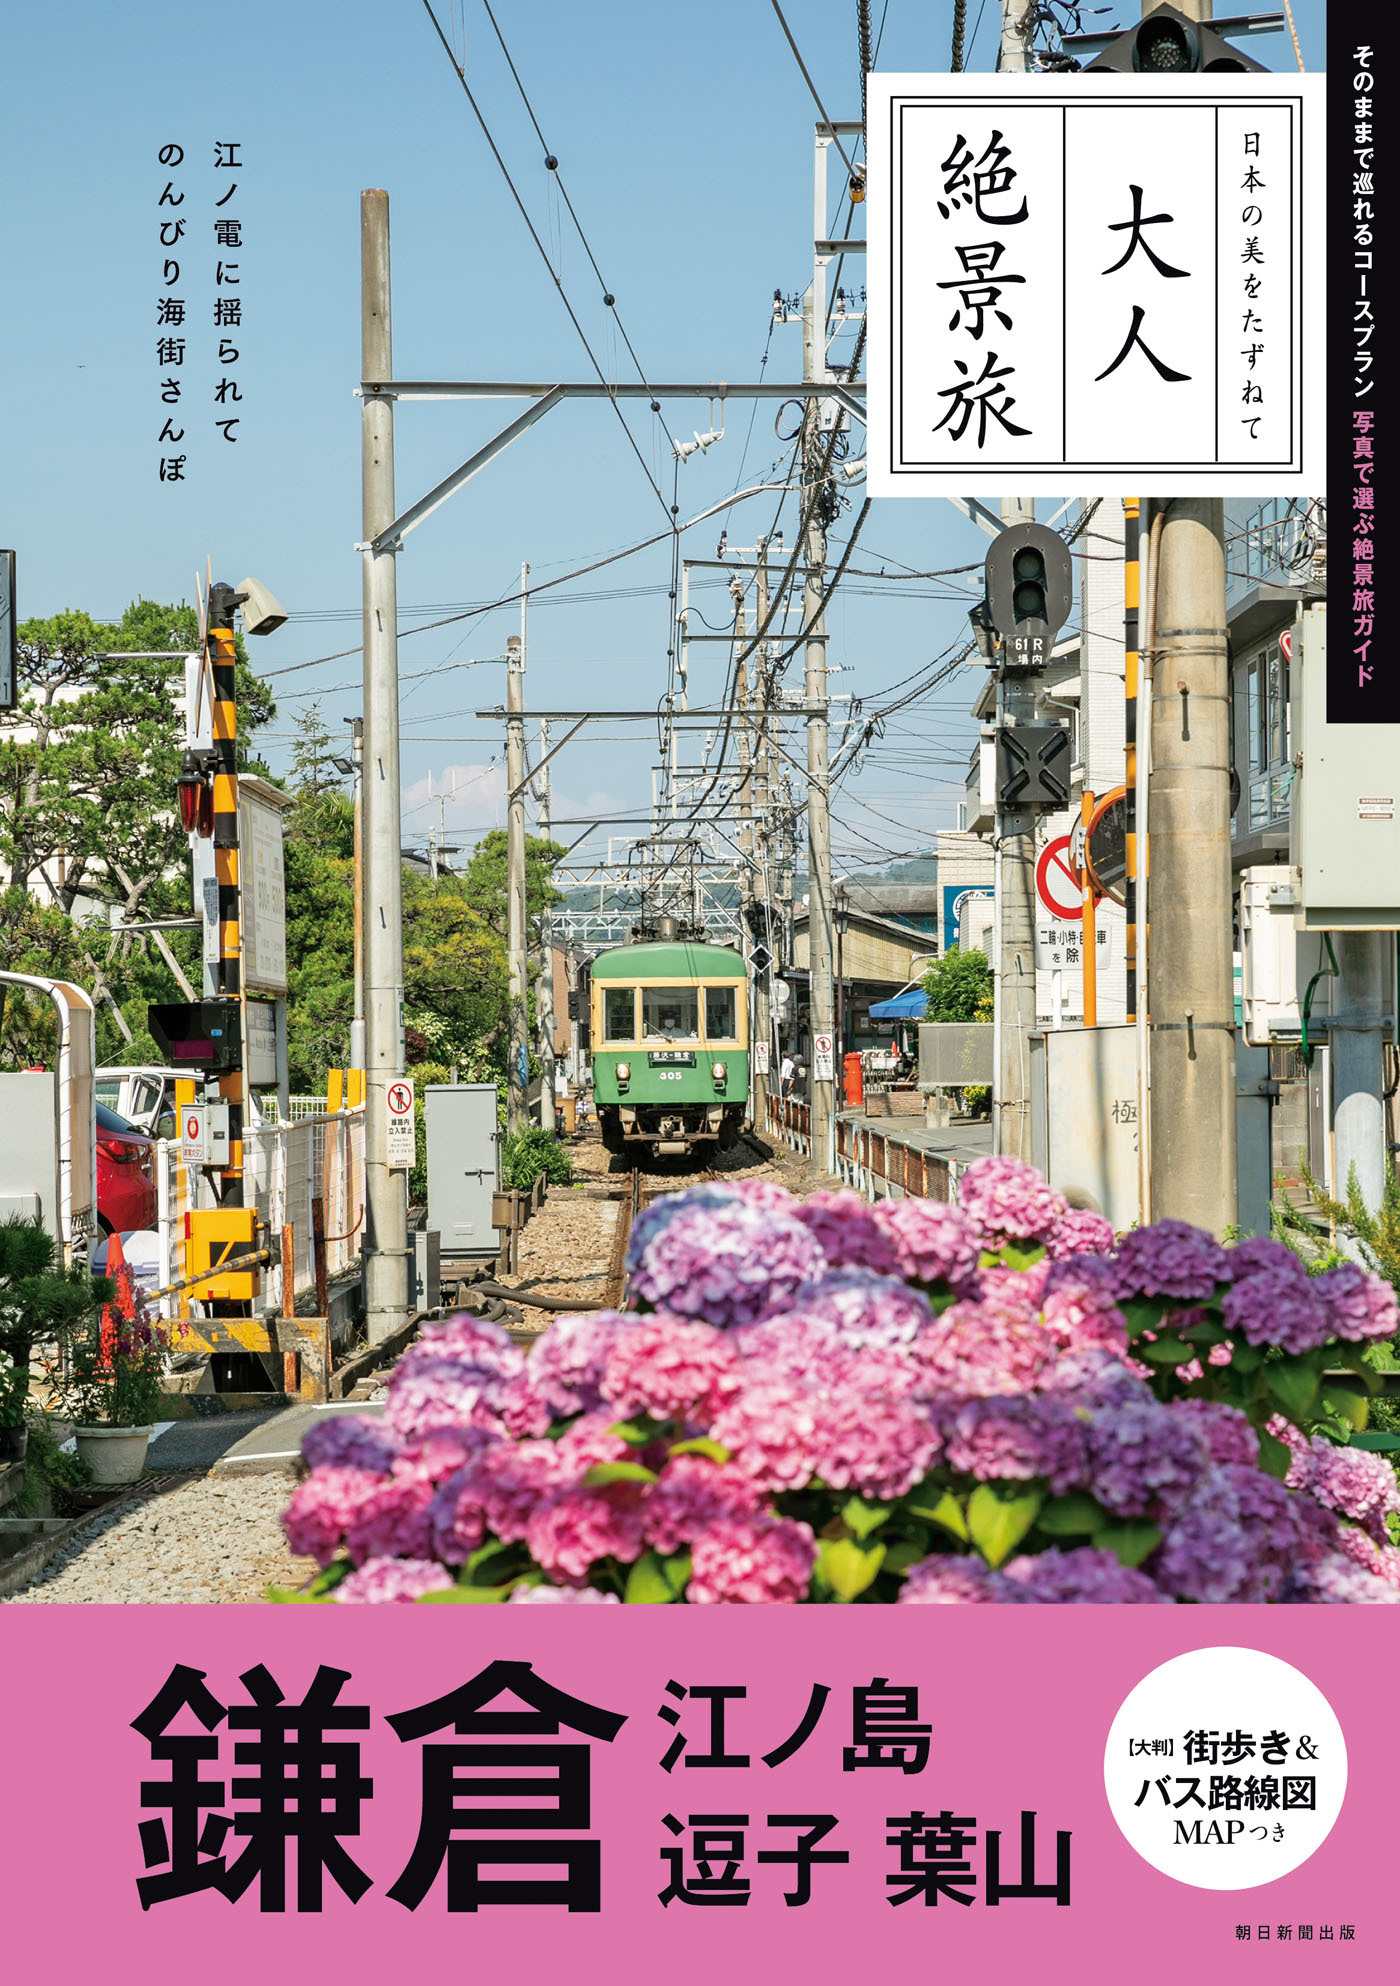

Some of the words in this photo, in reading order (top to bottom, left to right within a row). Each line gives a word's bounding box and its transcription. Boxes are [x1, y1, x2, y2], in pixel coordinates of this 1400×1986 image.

[1015, 638, 1028, 651] 61
[1033, 638, 1043, 651] R
[659, 1071, 682, 1080] 305
